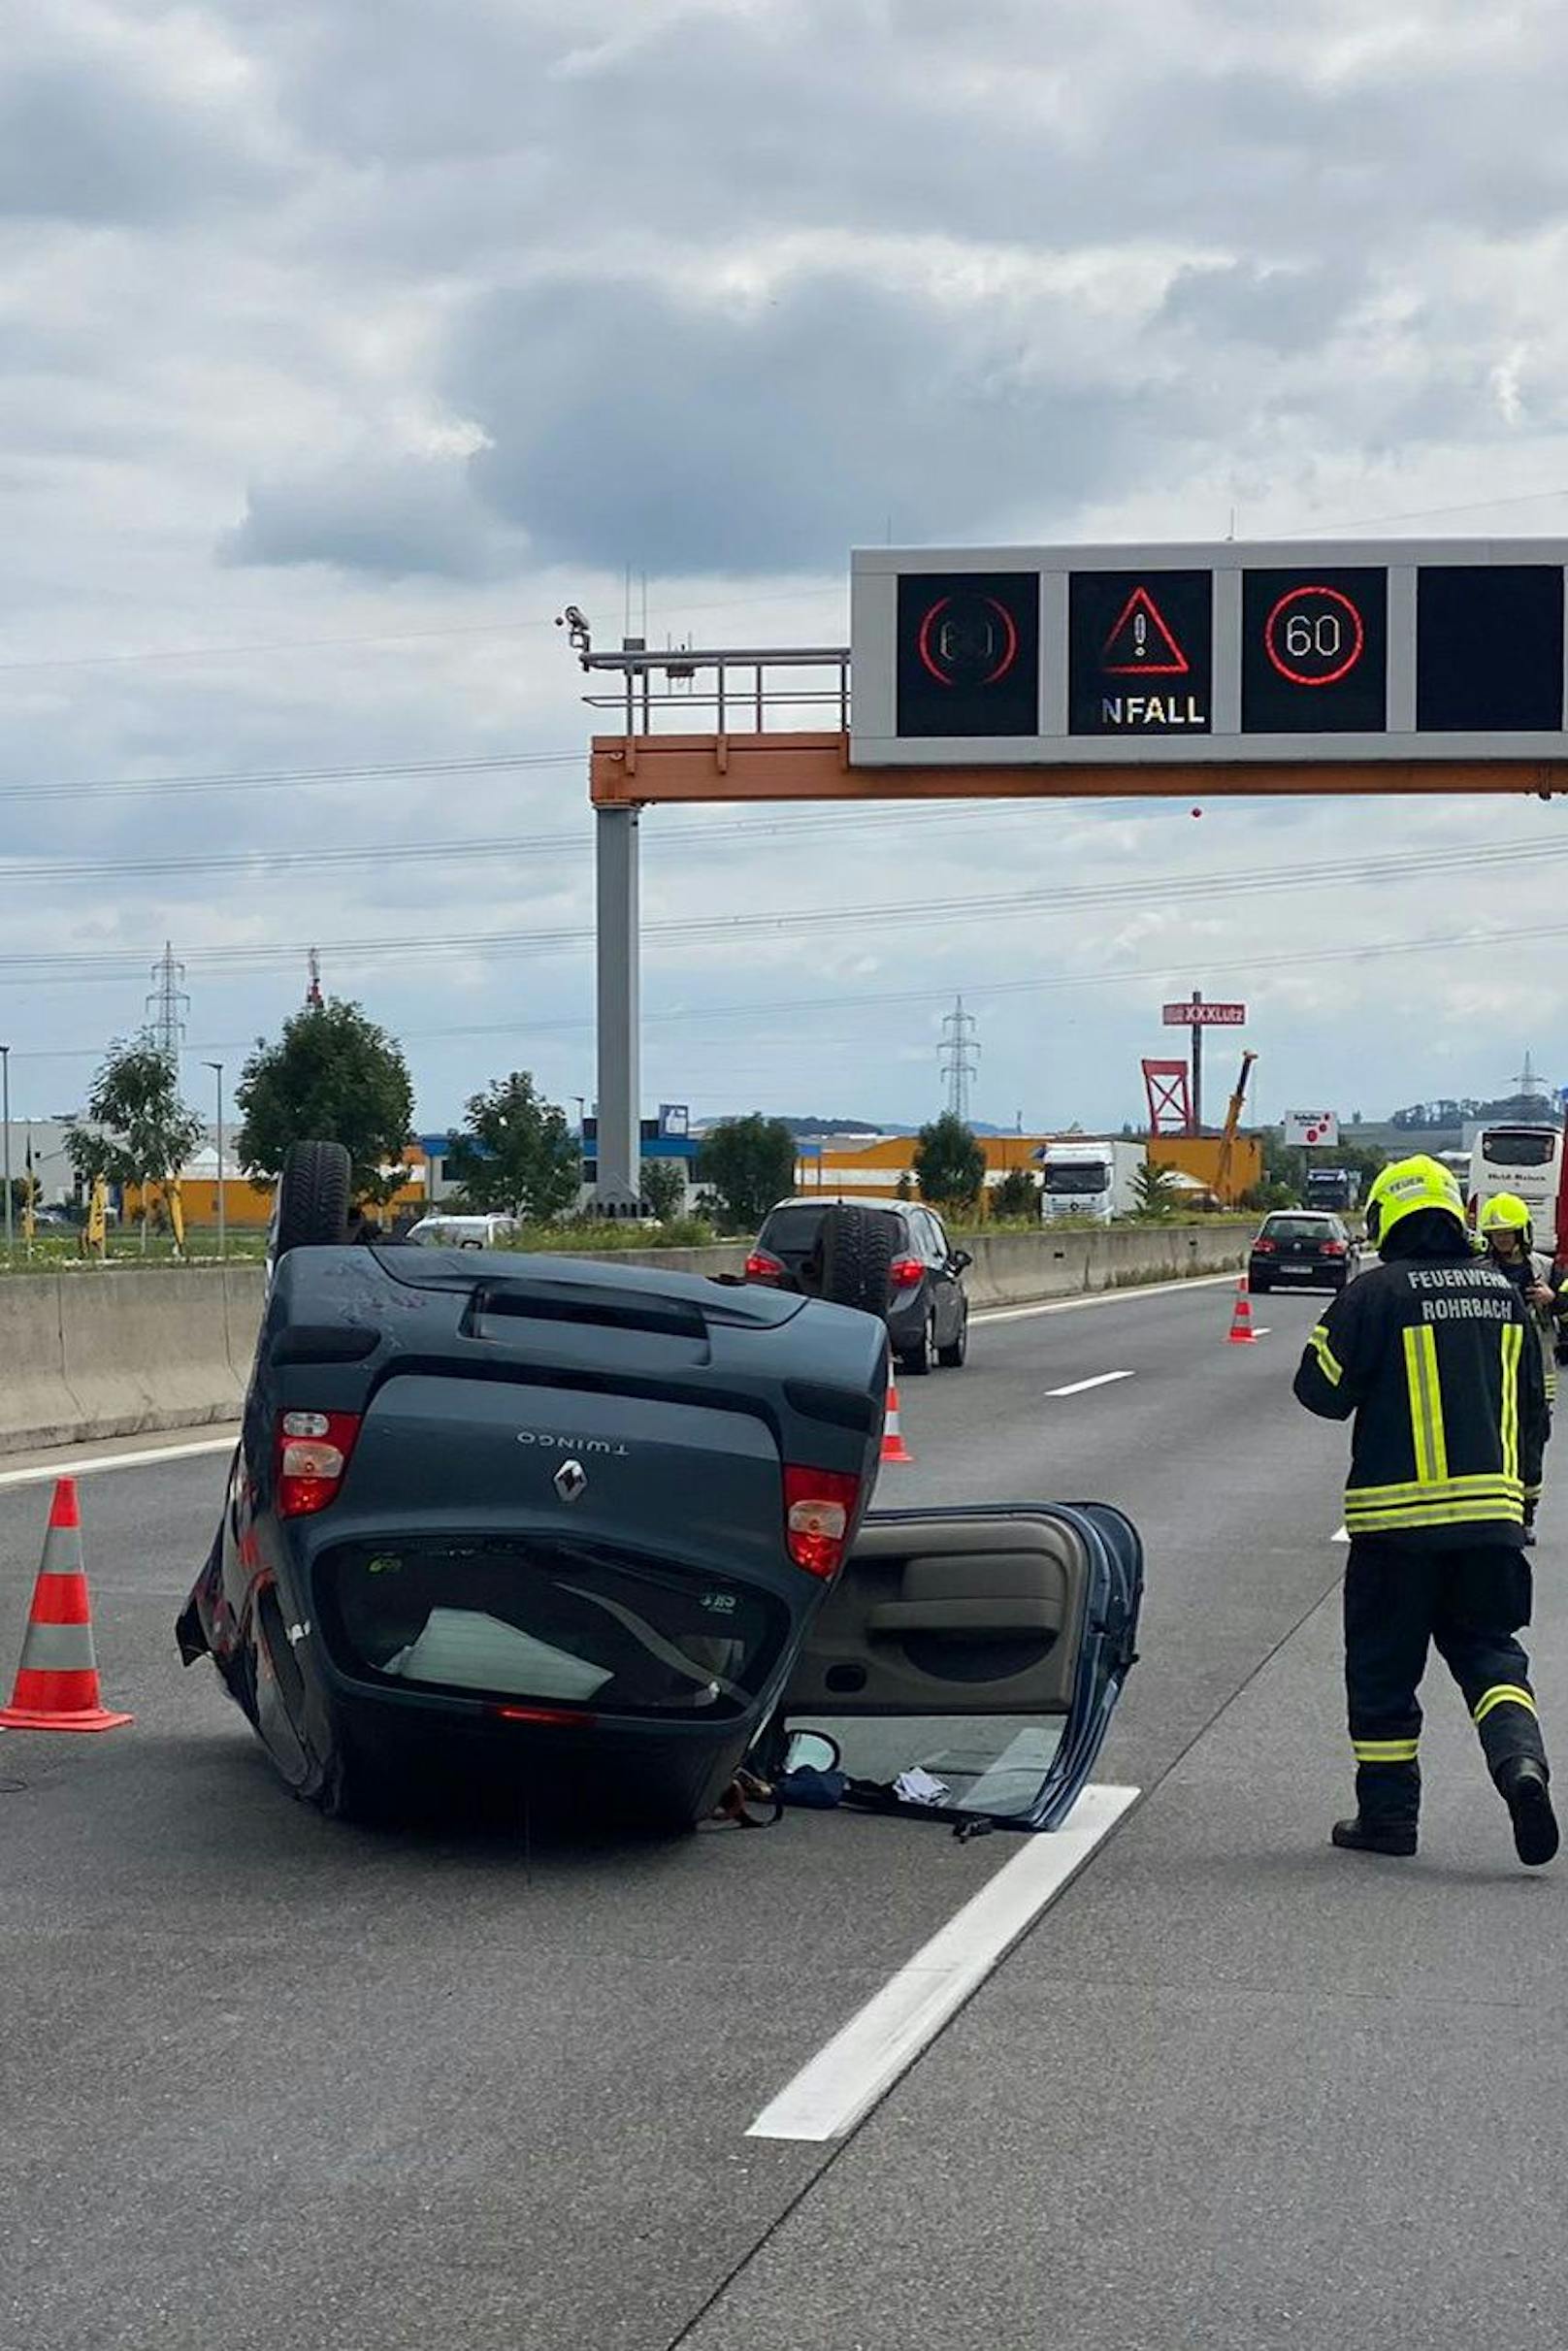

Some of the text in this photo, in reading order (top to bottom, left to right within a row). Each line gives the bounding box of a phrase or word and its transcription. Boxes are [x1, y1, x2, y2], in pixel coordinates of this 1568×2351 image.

[1286, 614, 1341, 657] 60
[1185, 1005, 1243, 1022] XXXLutz
[1421, 1298, 1514, 1321] ROHRBACH
[516, 1430, 630, 1456] TWINGO
